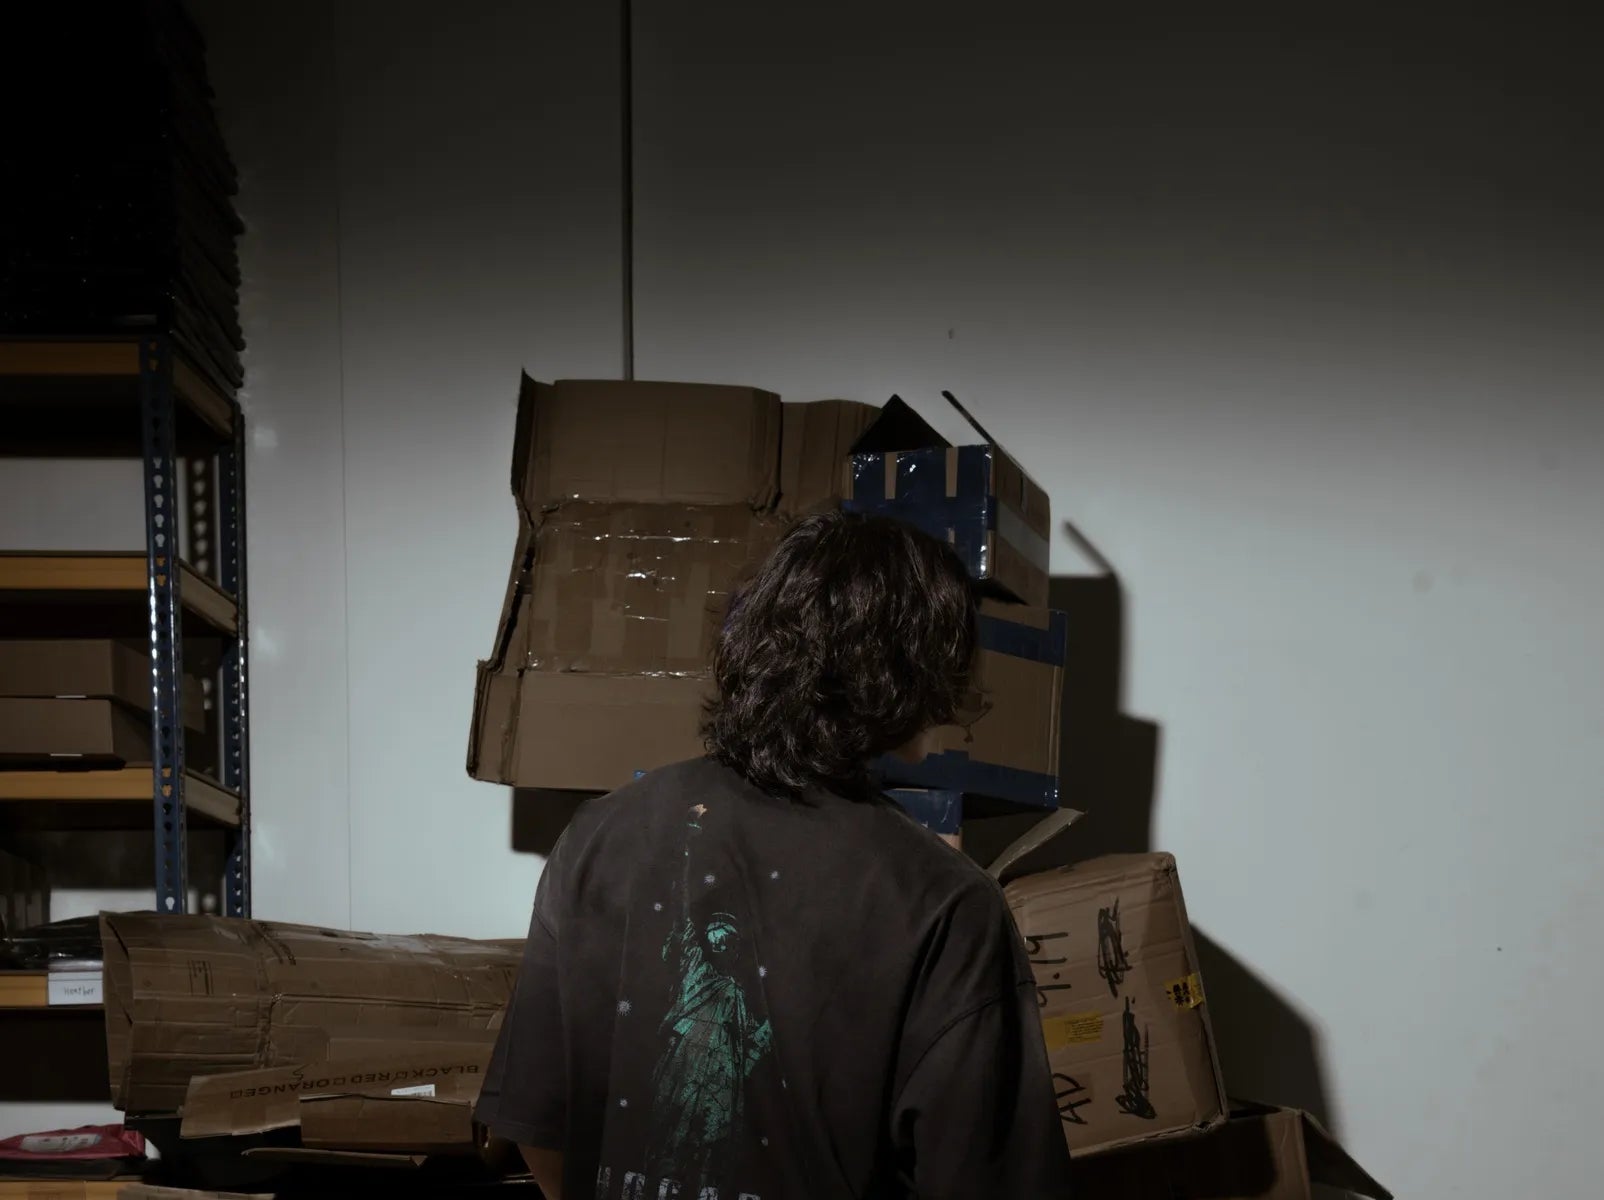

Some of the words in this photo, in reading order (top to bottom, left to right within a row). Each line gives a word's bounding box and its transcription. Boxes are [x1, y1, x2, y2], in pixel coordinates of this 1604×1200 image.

[350, 1072, 390, 1085] RED
[412, 1064, 479, 1080] BLACK
[243, 1078, 330, 1098] ORANGE
